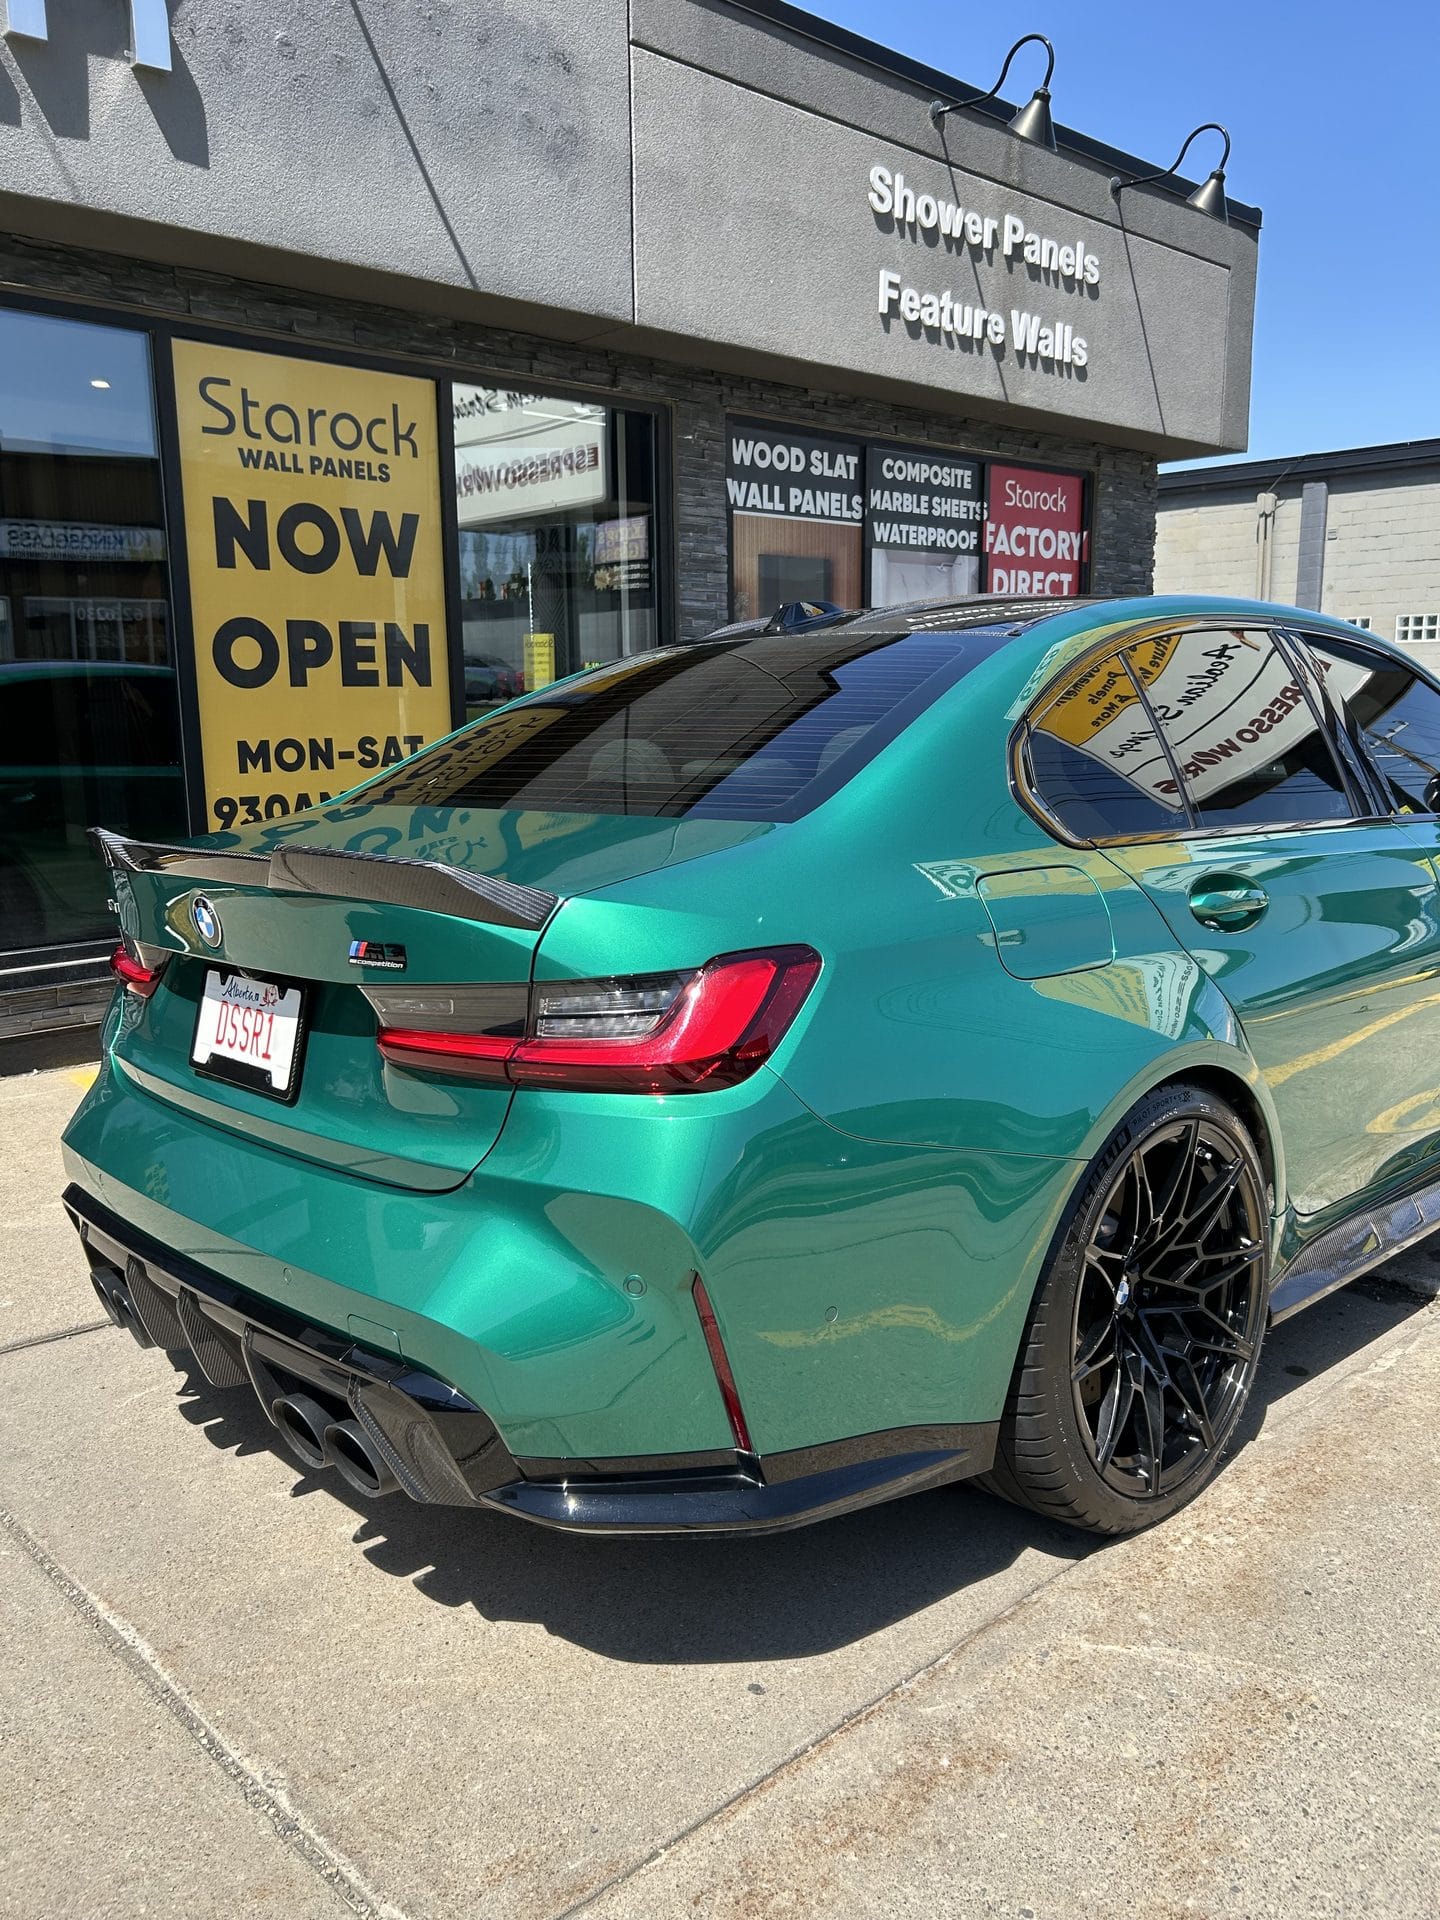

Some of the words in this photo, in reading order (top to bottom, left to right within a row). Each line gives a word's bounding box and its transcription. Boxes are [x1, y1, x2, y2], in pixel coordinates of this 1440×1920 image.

[868, 166, 998, 249] Shower
[1003, 213, 1100, 285] Panels
[878, 269, 1006, 345] Feature
[1010, 309, 1089, 367] Walls
[199, 376, 420, 460] Starock
[237, 447, 304, 475] WALL
[309, 456, 392, 484] PANELS
[732, 437, 806, 473] WOOD
[809, 449, 859, 480] SLAT
[881, 457, 973, 490] COMPOSITE
[726, 477, 785, 512] WALL
[789, 487, 863, 520] PANELS
[869, 488, 929, 515] MARBLE
[931, 496, 989, 522] SHEETS
[1004, 479, 1067, 513] Starock
[211, 495, 421, 579] NOW
[873, 521, 978, 550] WATERPROOF
[985, 521, 1089, 561] FACTORY
[992, 568, 1073, 596] DIRECT
[212, 616, 433, 690] OPEN
[236, 735, 425, 775] MON-SAT
[213, 791, 348, 831] 930A
[357, 959, 404, 969] competition
[221, 975, 256, 1002] Alberta
[215, 1001, 276, 1060] DSSR1
